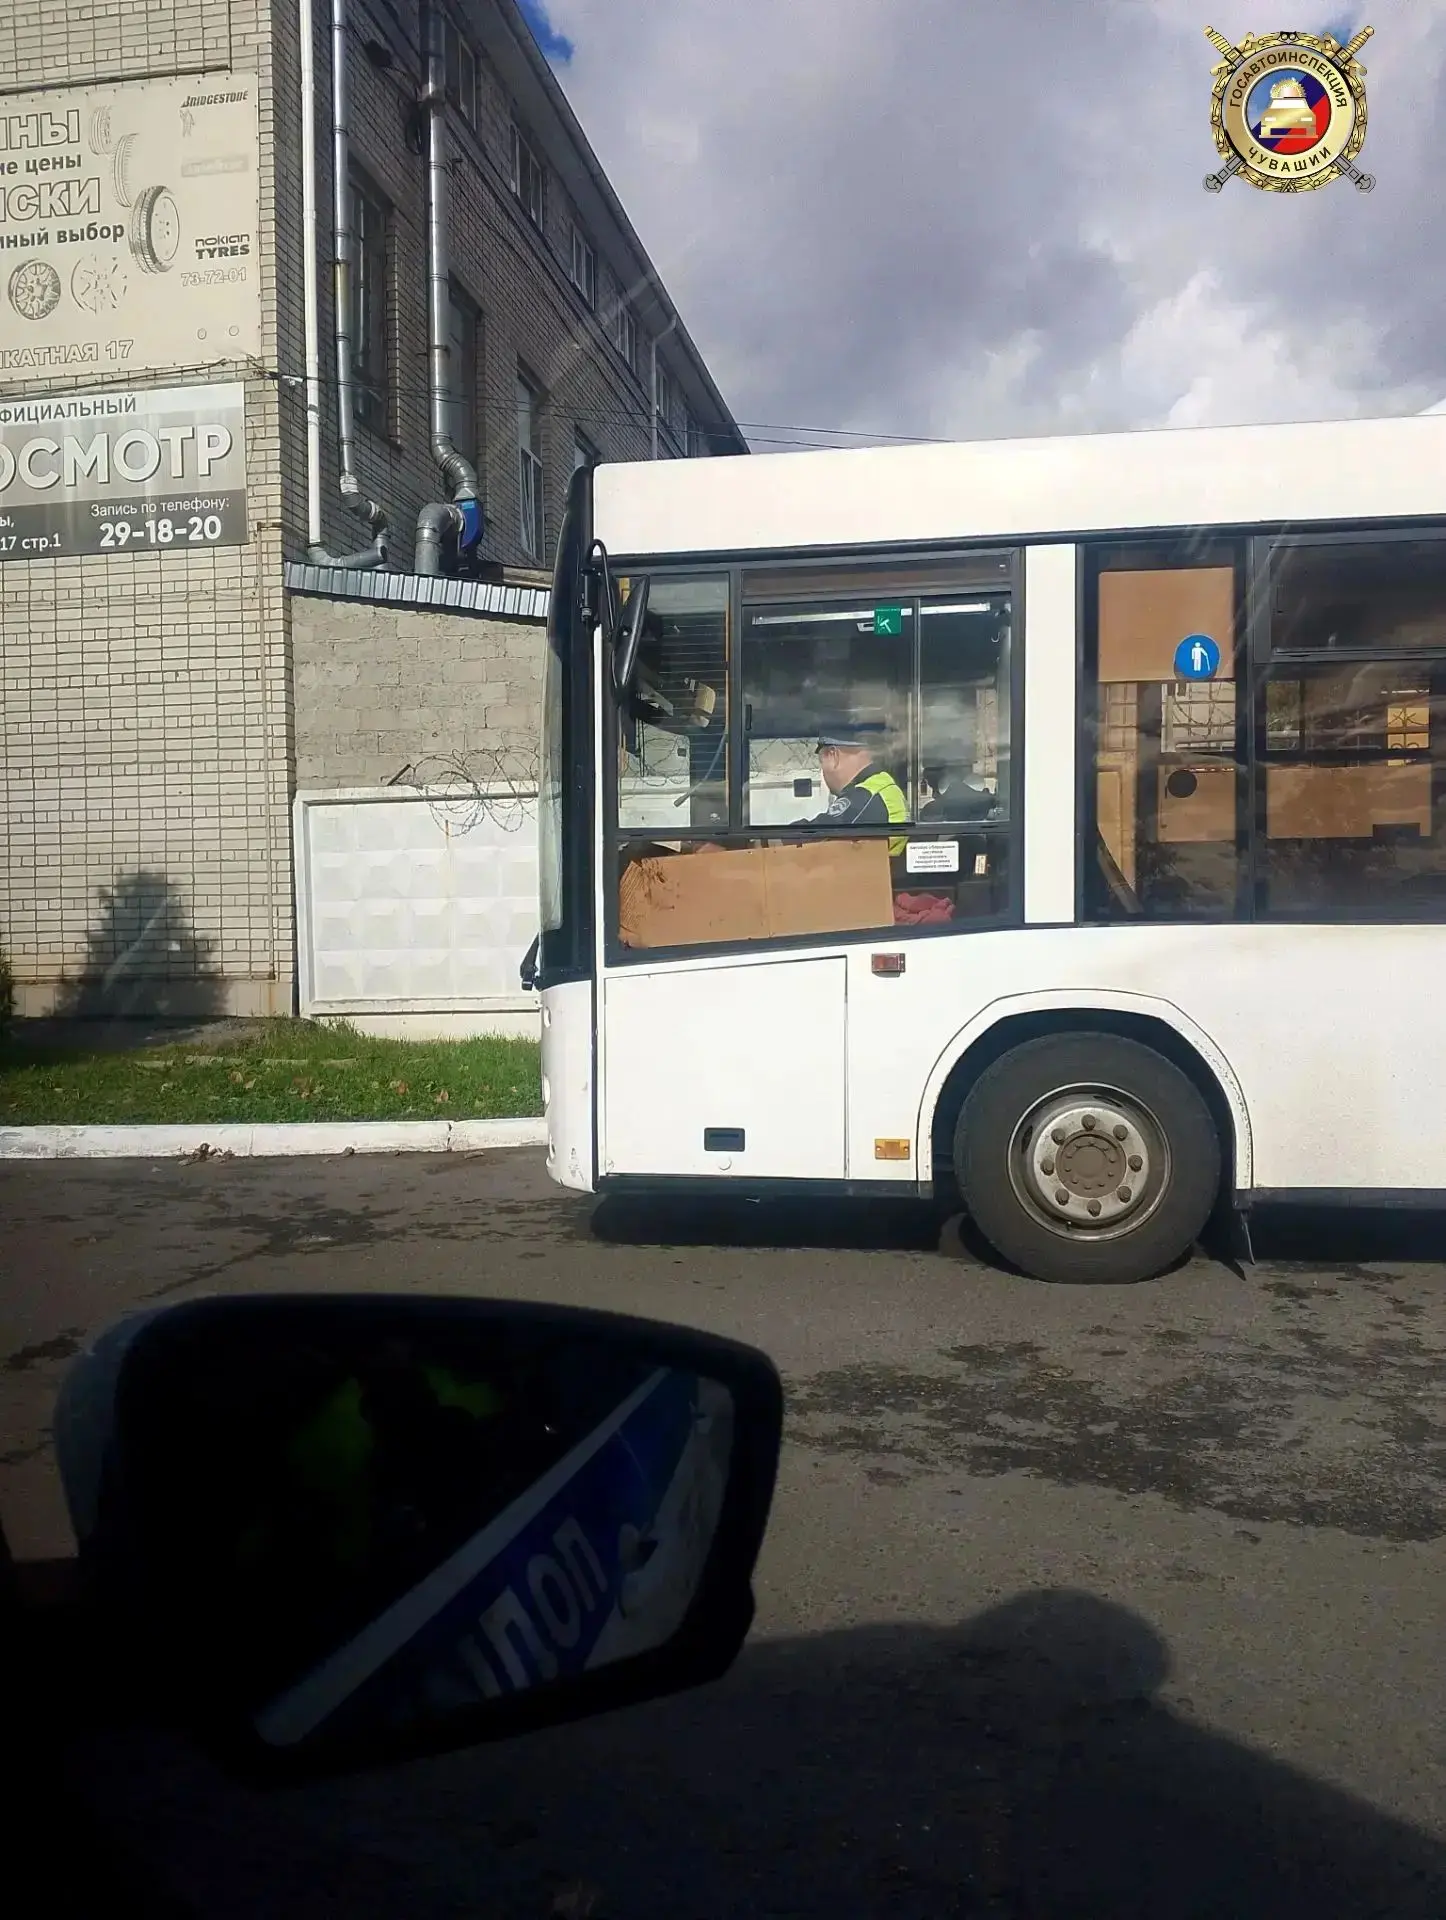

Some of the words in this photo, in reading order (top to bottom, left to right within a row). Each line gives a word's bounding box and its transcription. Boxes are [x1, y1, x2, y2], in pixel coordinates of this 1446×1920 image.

[180, 90, 249, 108] BRIDGESTONE
[0, 108, 81, 151] НЫ
[25, 153, 82, 176] цены
[0, 176, 101, 223] СКИ
[56, 221, 125, 244] выбор
[195, 244, 250, 260] TYRES
[181, 266, 247, 288] 73-72-01
[0, 342, 98, 369] КАТНАЯ
[105, 339, 134, 360] 17
[0, 393, 137, 423] ФИЦИАЛЬНЫЙ
[91, 503, 138, 517] Запись
[141, 502, 157, 514] по
[160, 496, 230, 513] телефону:
[0, 536, 17, 551] 17
[22, 532, 62, 552] стр.1
[100, 515, 222, 547] 29-18-20
